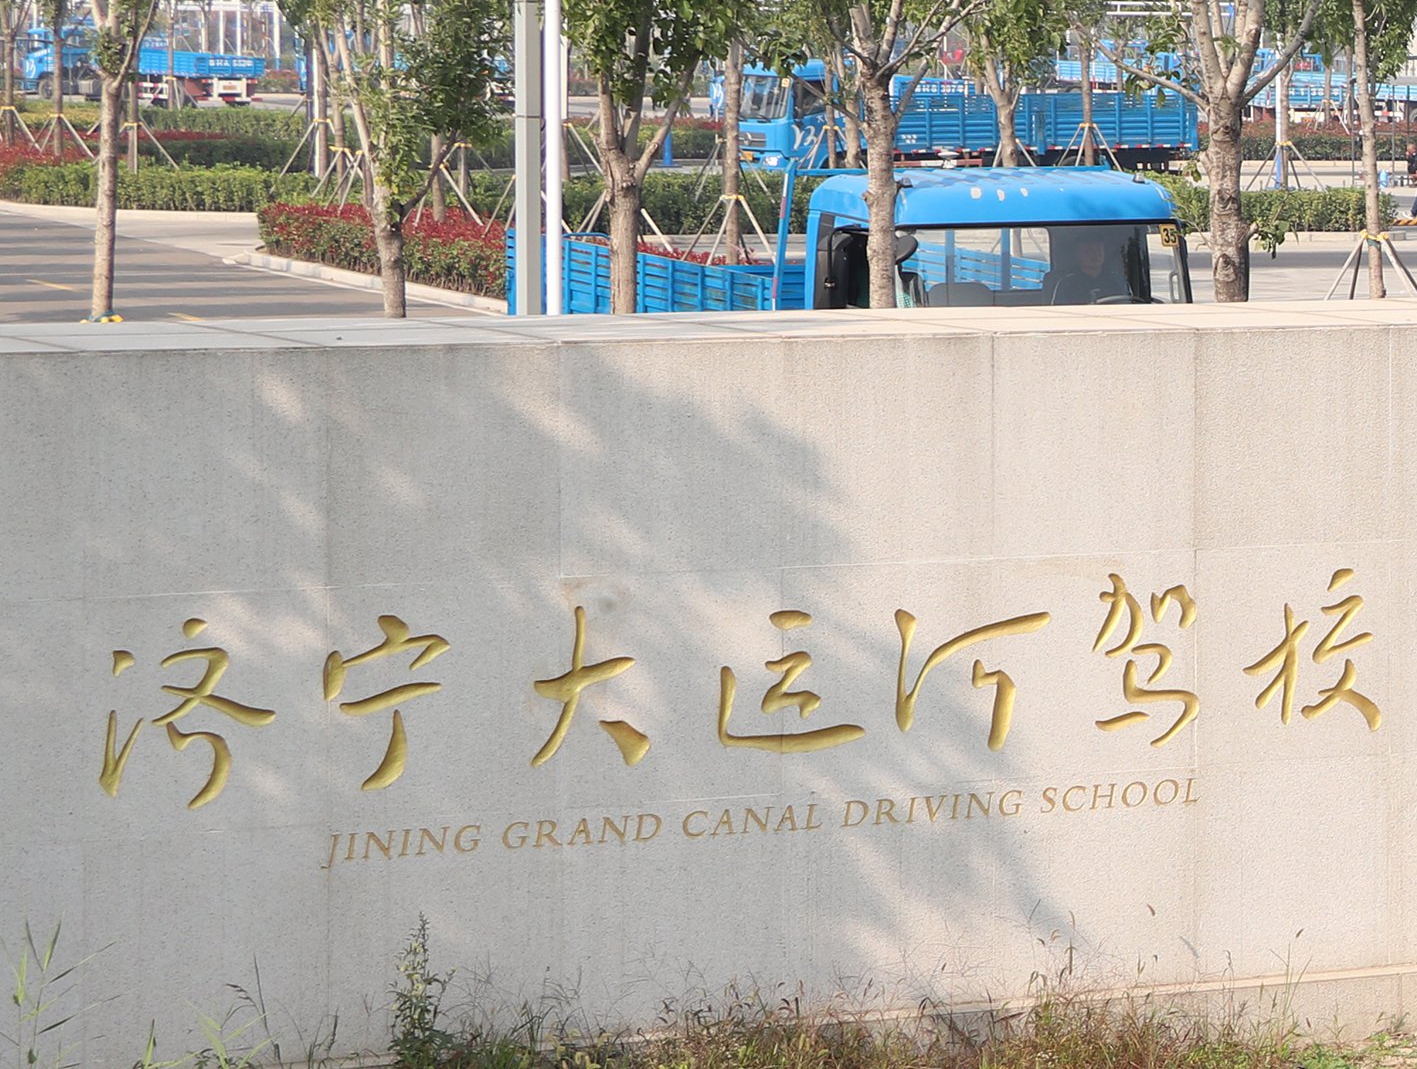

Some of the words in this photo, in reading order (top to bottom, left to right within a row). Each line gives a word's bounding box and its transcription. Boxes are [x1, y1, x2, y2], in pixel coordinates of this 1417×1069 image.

[99, 568, 1382, 809] 济宁大运河驾校
[319, 824, 482, 870] JINING
[501, 813, 663, 849] GRAND
[682, 803, 823, 838] CANAL
[840, 789, 1024, 828] DRIVING
[1040, 777, 1202, 814] SCHOOL
